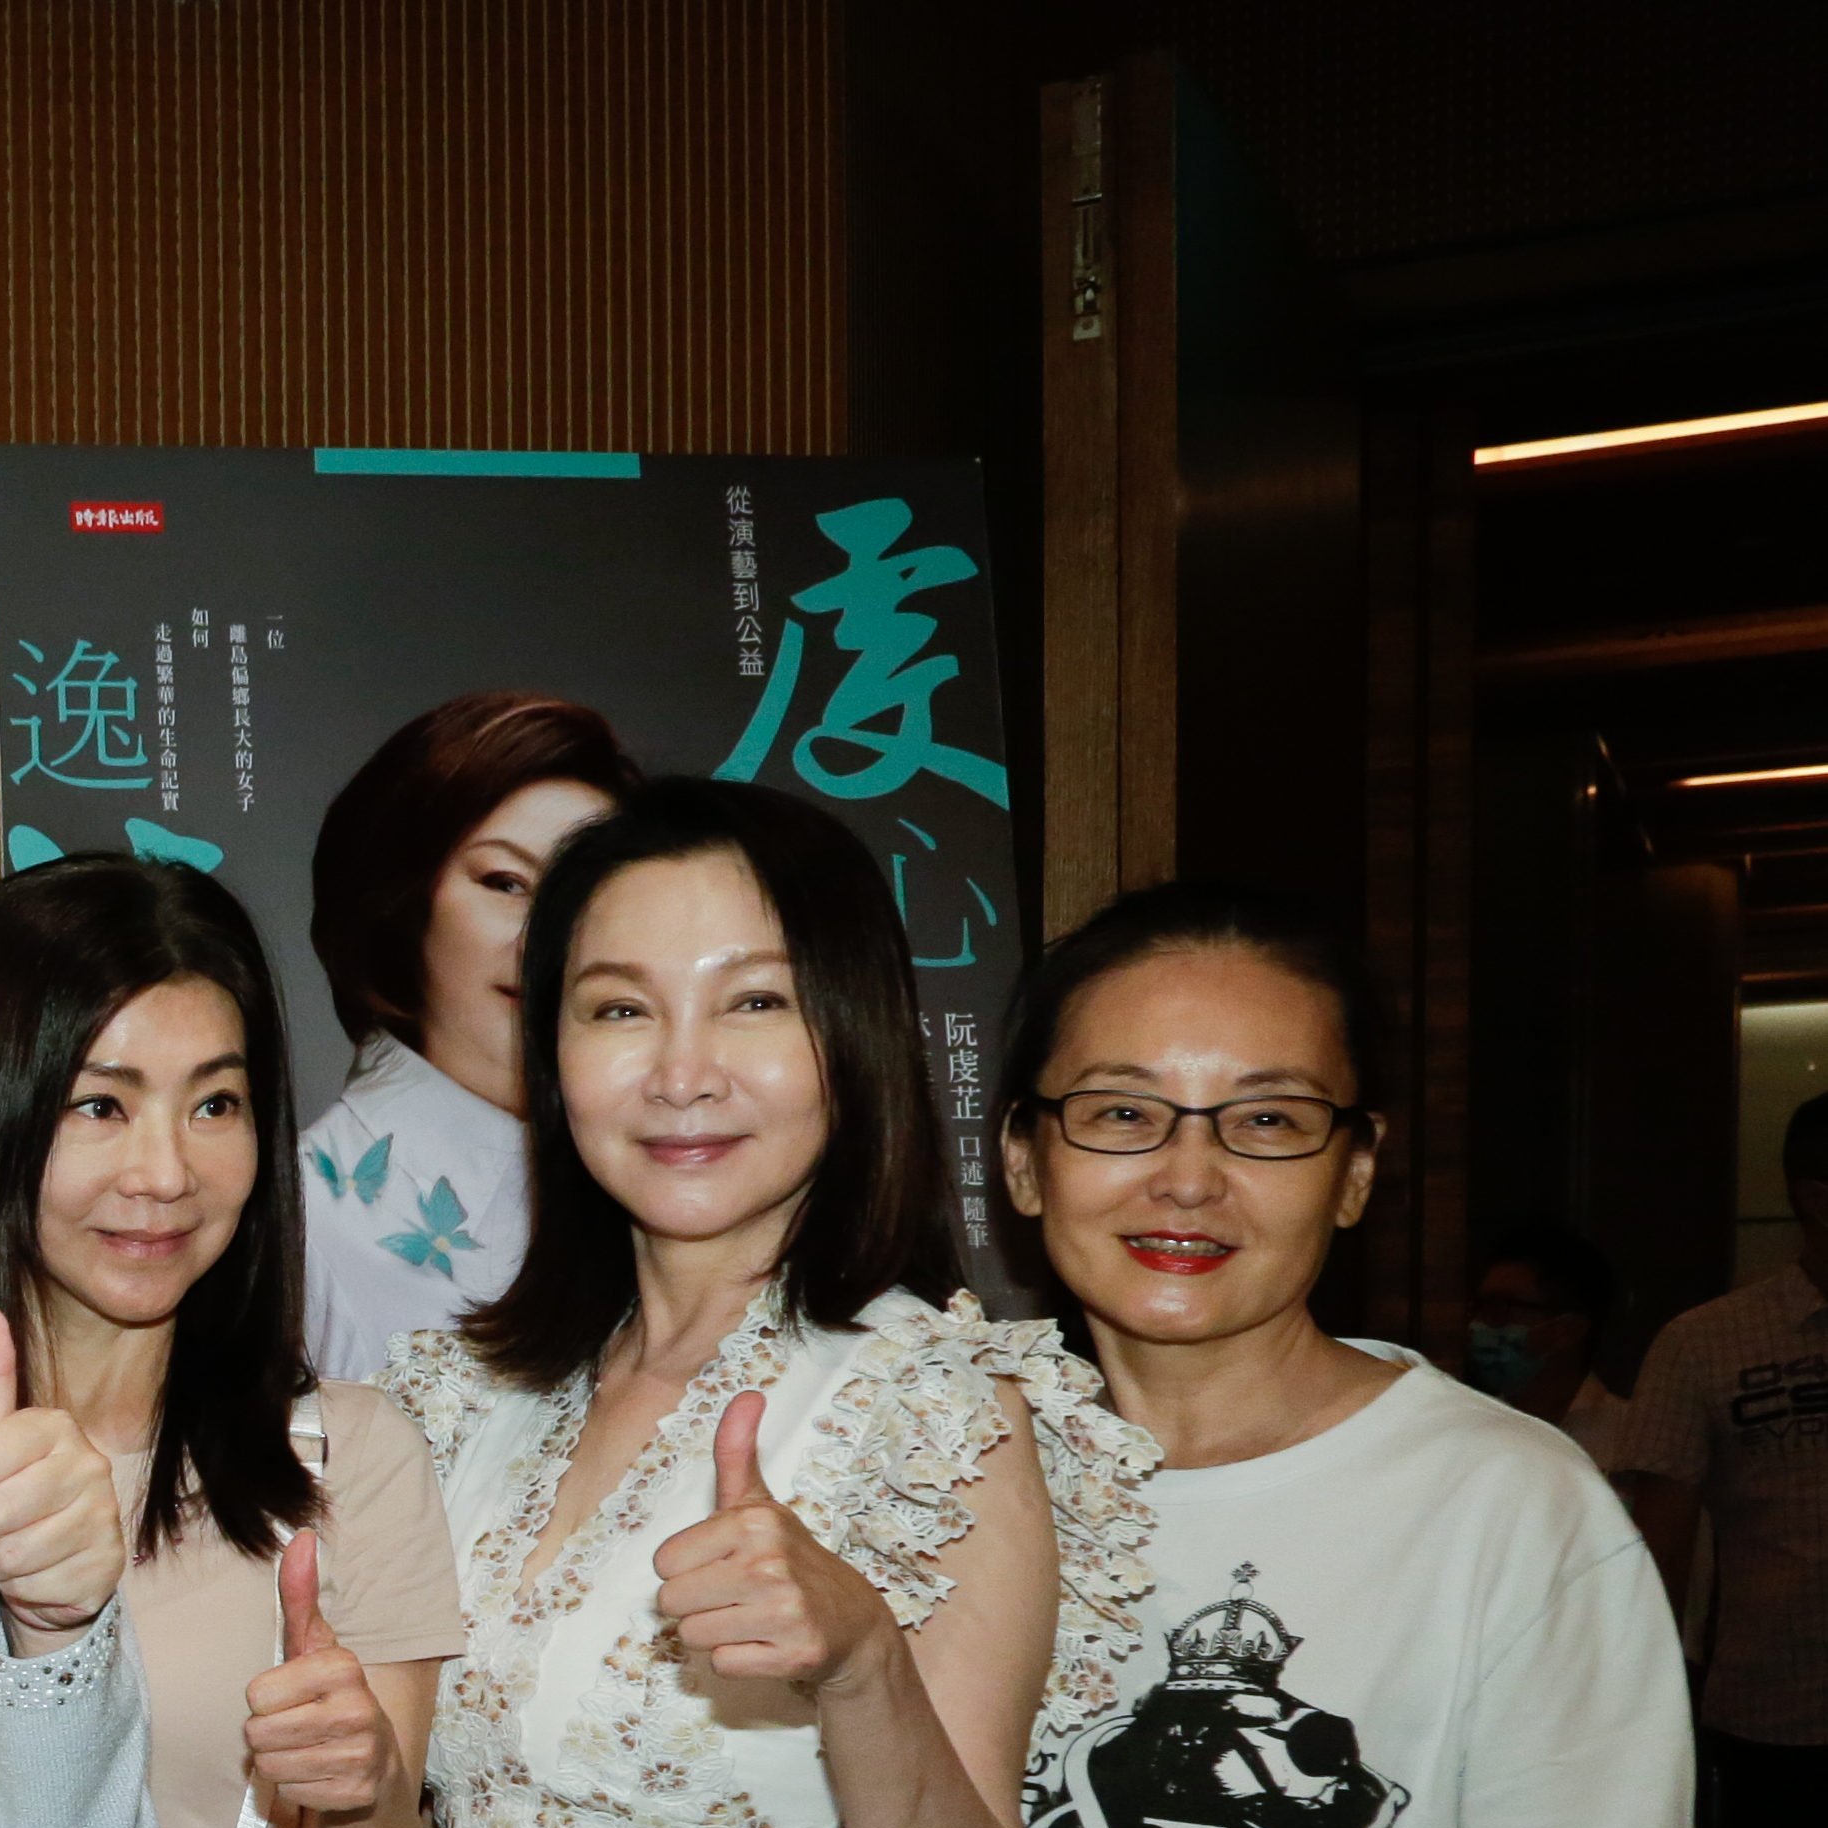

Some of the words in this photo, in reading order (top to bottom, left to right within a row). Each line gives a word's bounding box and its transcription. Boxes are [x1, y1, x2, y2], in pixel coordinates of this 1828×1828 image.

[75, 508, 159, 529] 時報出版
[725, 485, 765, 676] 從演藝到公益
[191, 607, 209, 649] 如何
[266, 612, 285, 650] 一位
[10, 638, 154, 790] 逸
[154, 623, 179, 812] 走過繁華的生命記實
[228, 624, 255, 812] 離島偏鄉長大的女子
[959, 1136, 984, 1187] 口述
[963, 1195, 989, 1249] 隨筆
